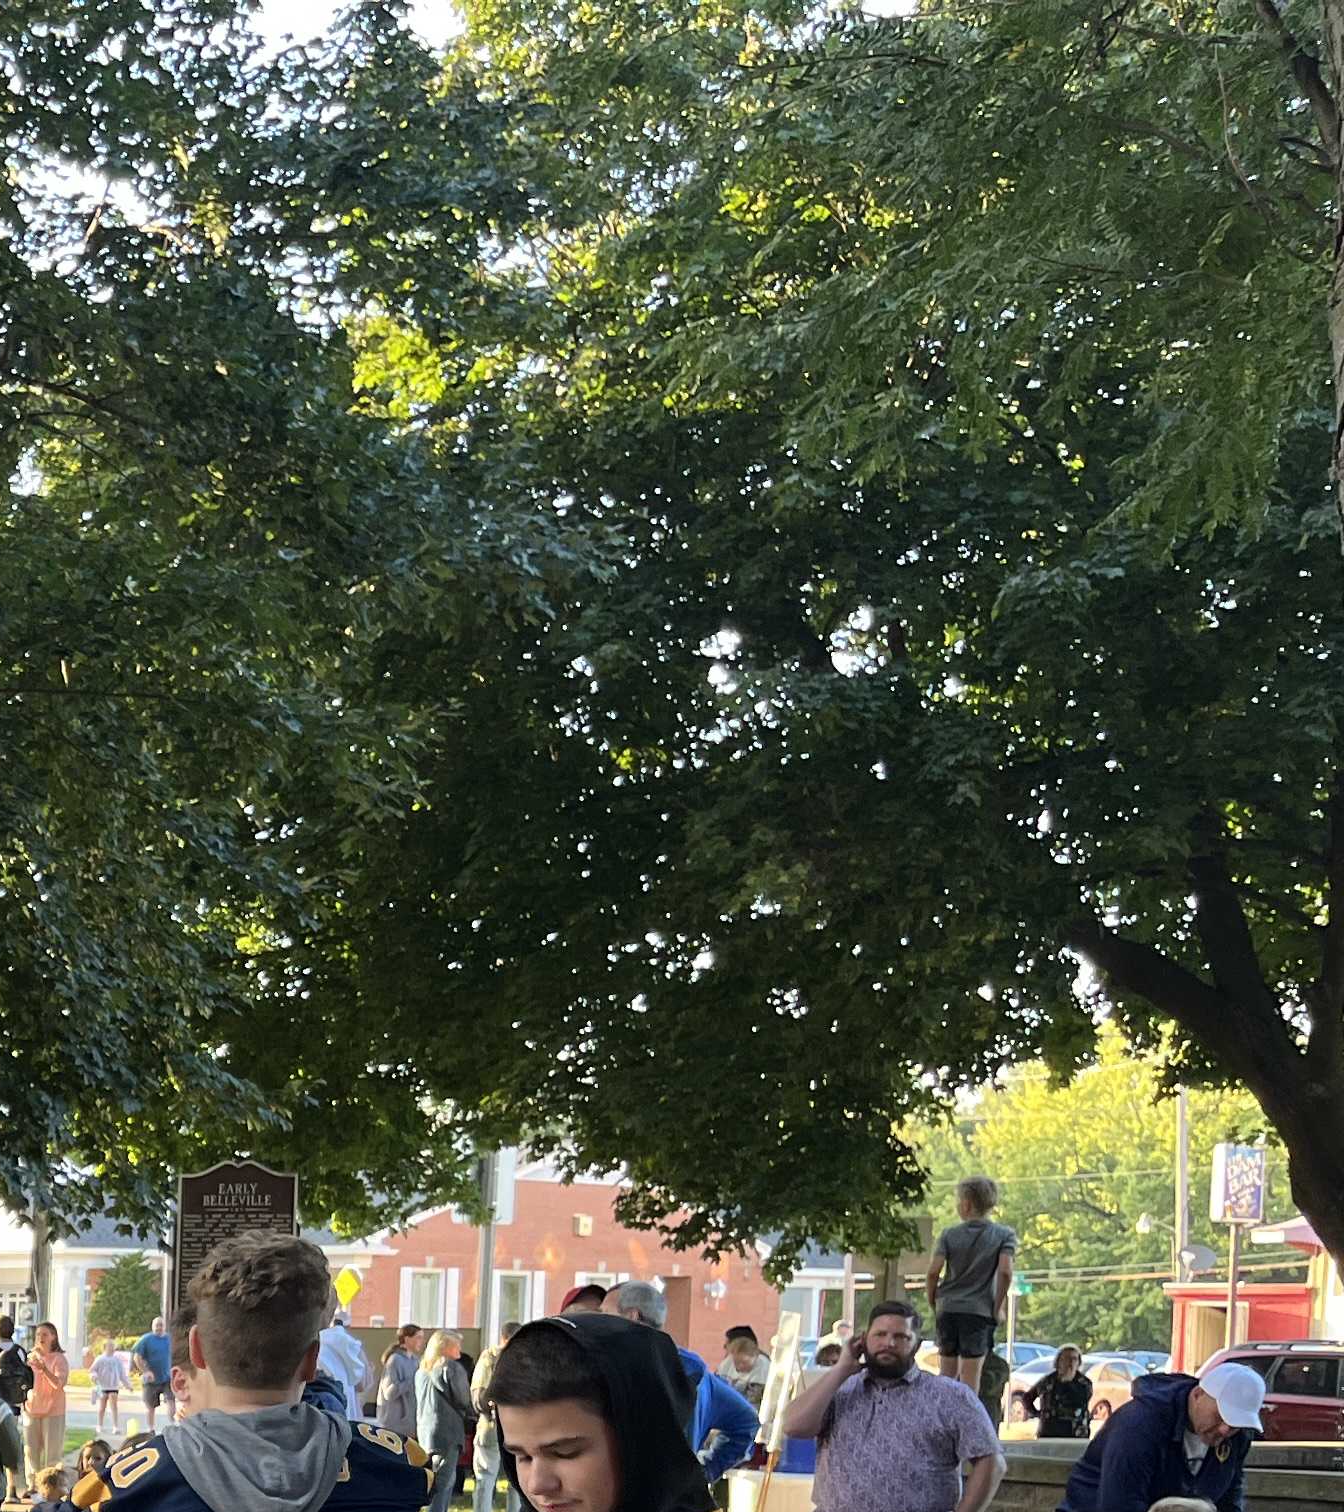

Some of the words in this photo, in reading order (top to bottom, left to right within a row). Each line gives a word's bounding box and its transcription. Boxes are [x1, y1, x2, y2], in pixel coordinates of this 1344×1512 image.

[1228, 1167, 1262, 1194] BAR
[218, 1183, 258, 1195] EARLY
[203, 1195, 272, 1207] BELLEVILLE
